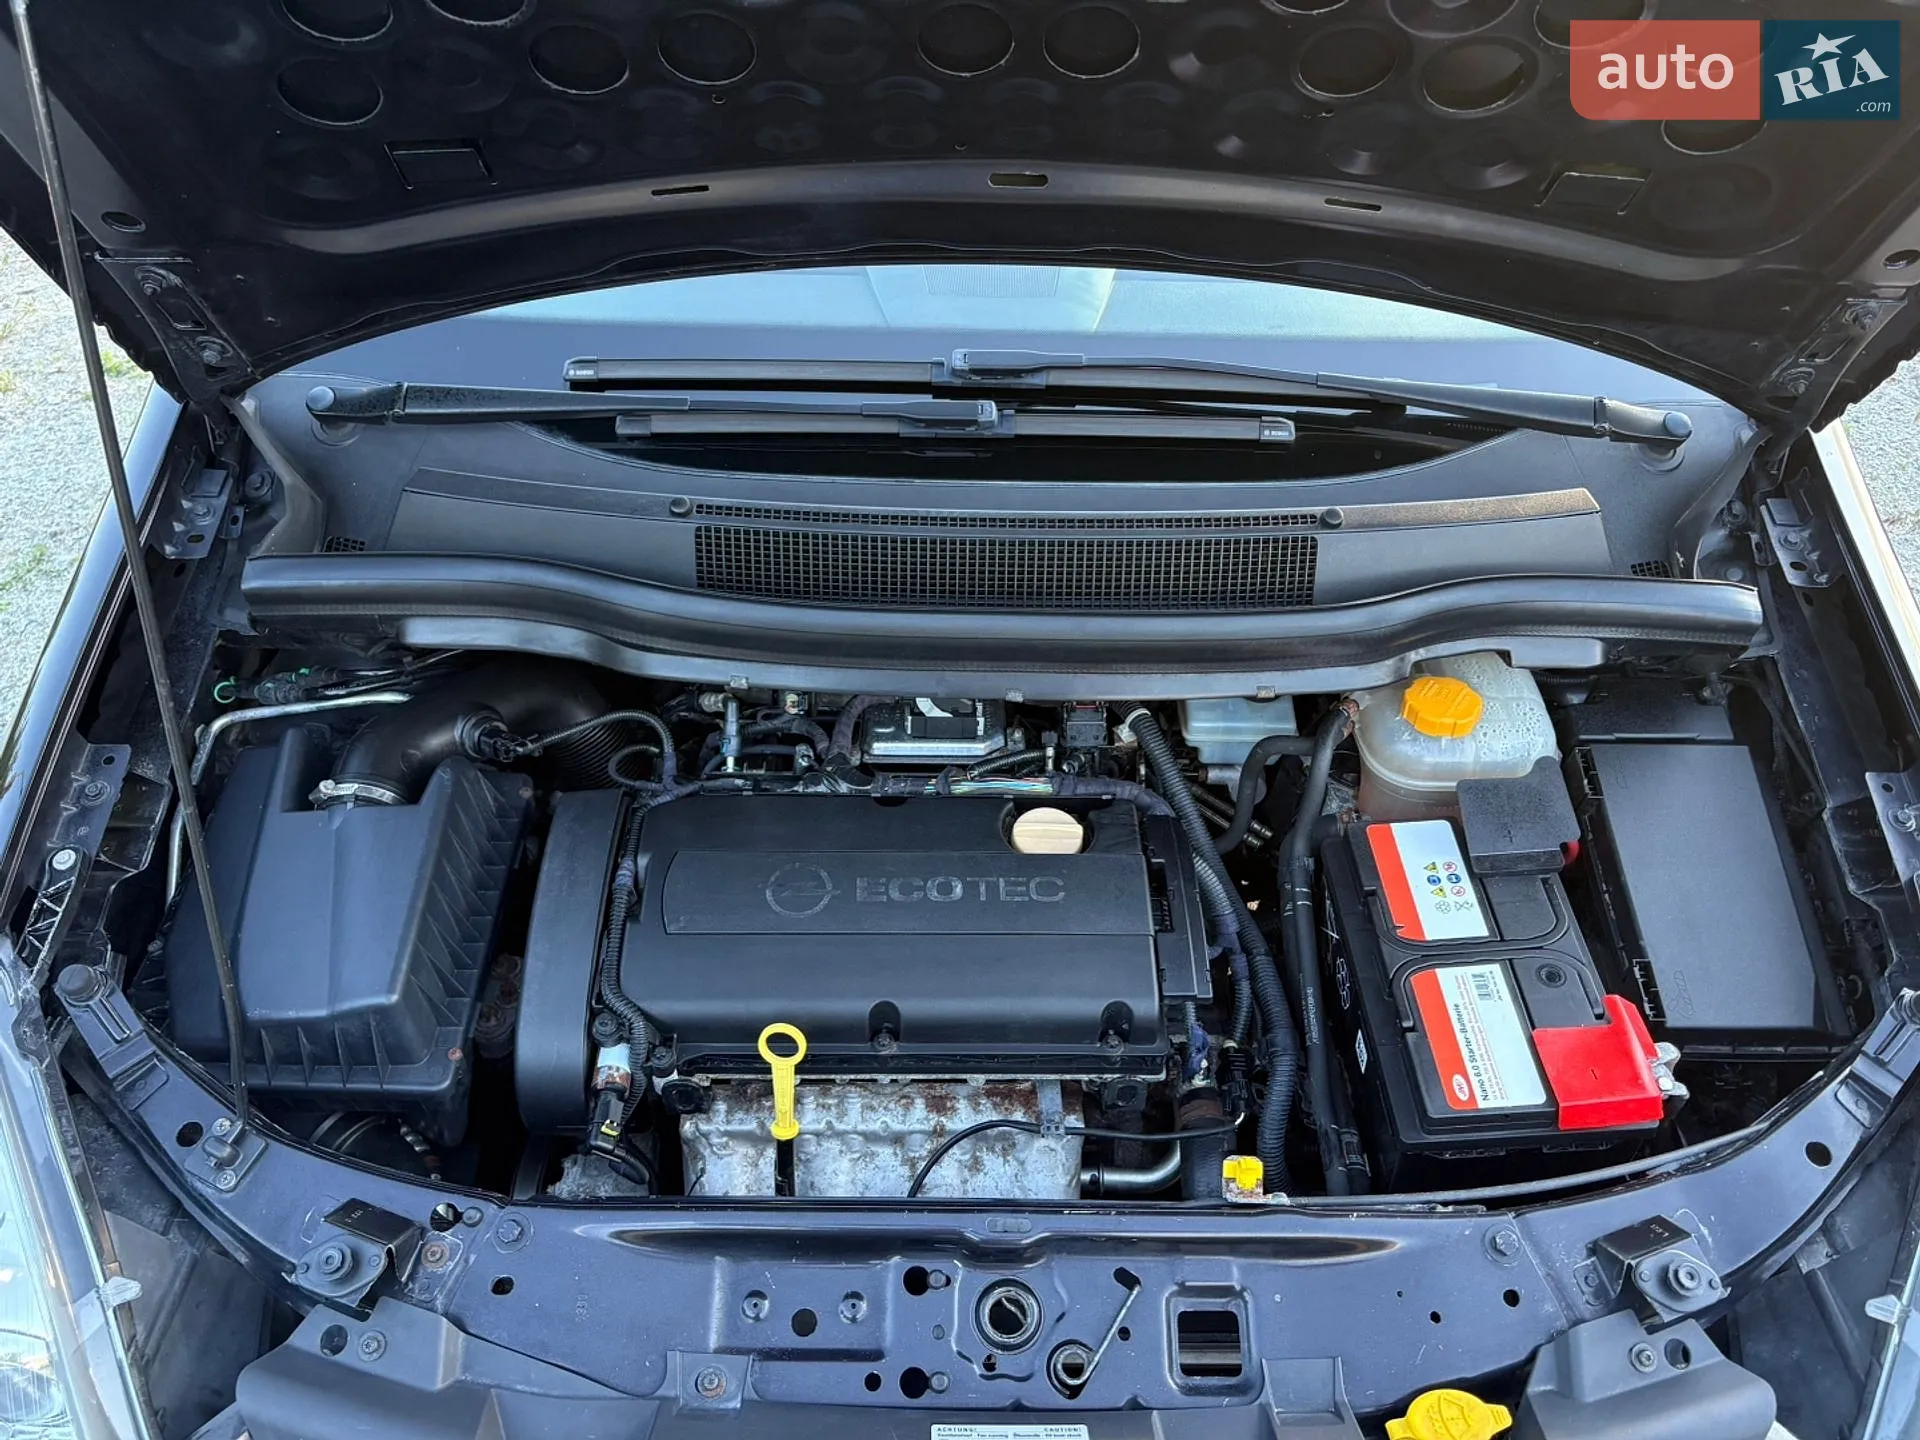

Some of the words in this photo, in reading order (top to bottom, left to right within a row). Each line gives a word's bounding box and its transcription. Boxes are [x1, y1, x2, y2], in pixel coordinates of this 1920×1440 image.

[856, 876, 1066, 902] ECOTEC
[1453, 1003, 1478, 1063] Starter-Batterie
[1471, 1065, 1482, 1077] 6.0
[1478, 1078, 1491, 1101] Nano
